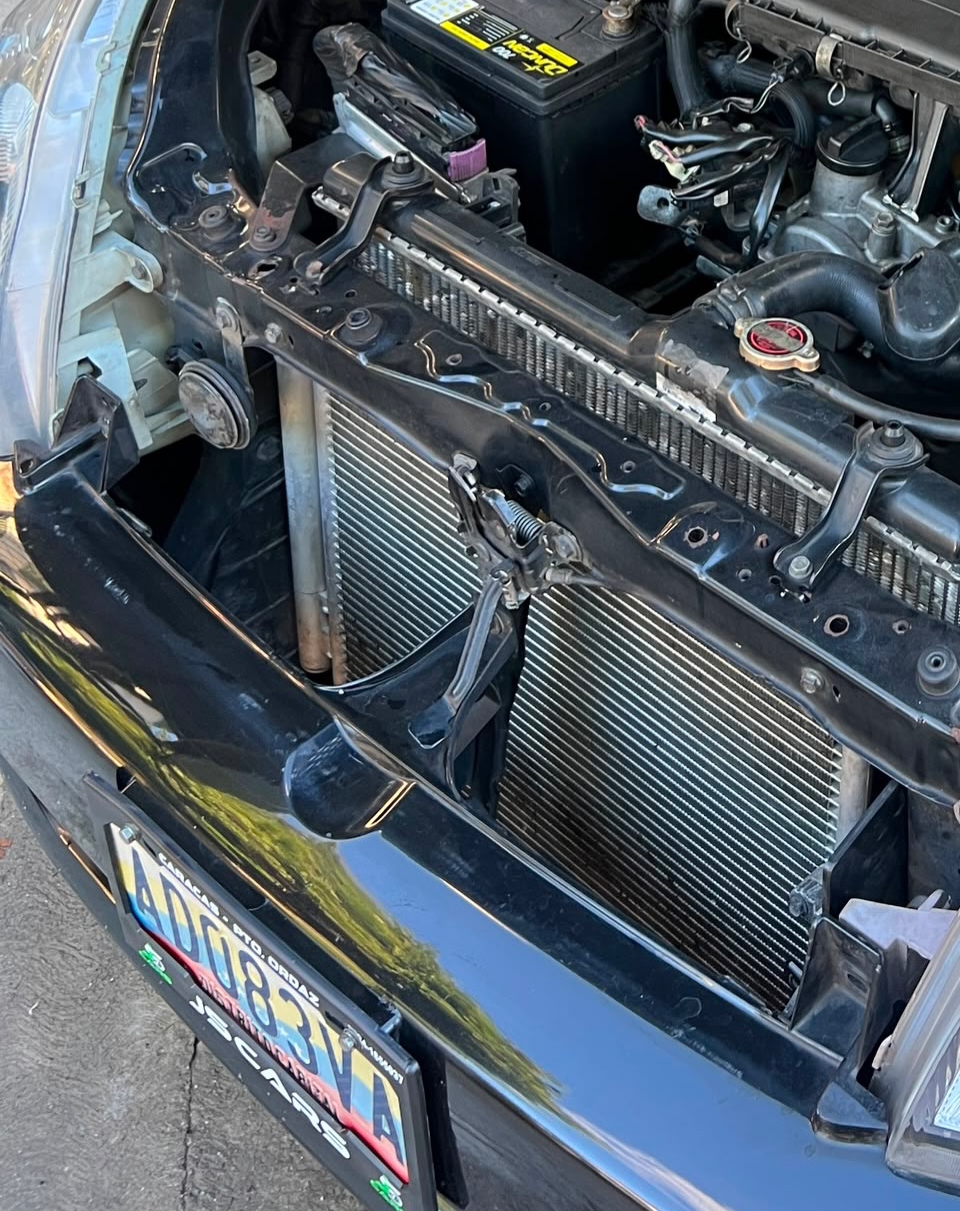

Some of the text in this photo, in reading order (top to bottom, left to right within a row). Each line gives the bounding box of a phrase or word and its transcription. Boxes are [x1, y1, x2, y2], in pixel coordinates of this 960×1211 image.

[130, 846, 405, 1158] AD083VA
[158, 852, 221, 922] CARACAS
[268, 958, 320, 1009] ORDAZ
